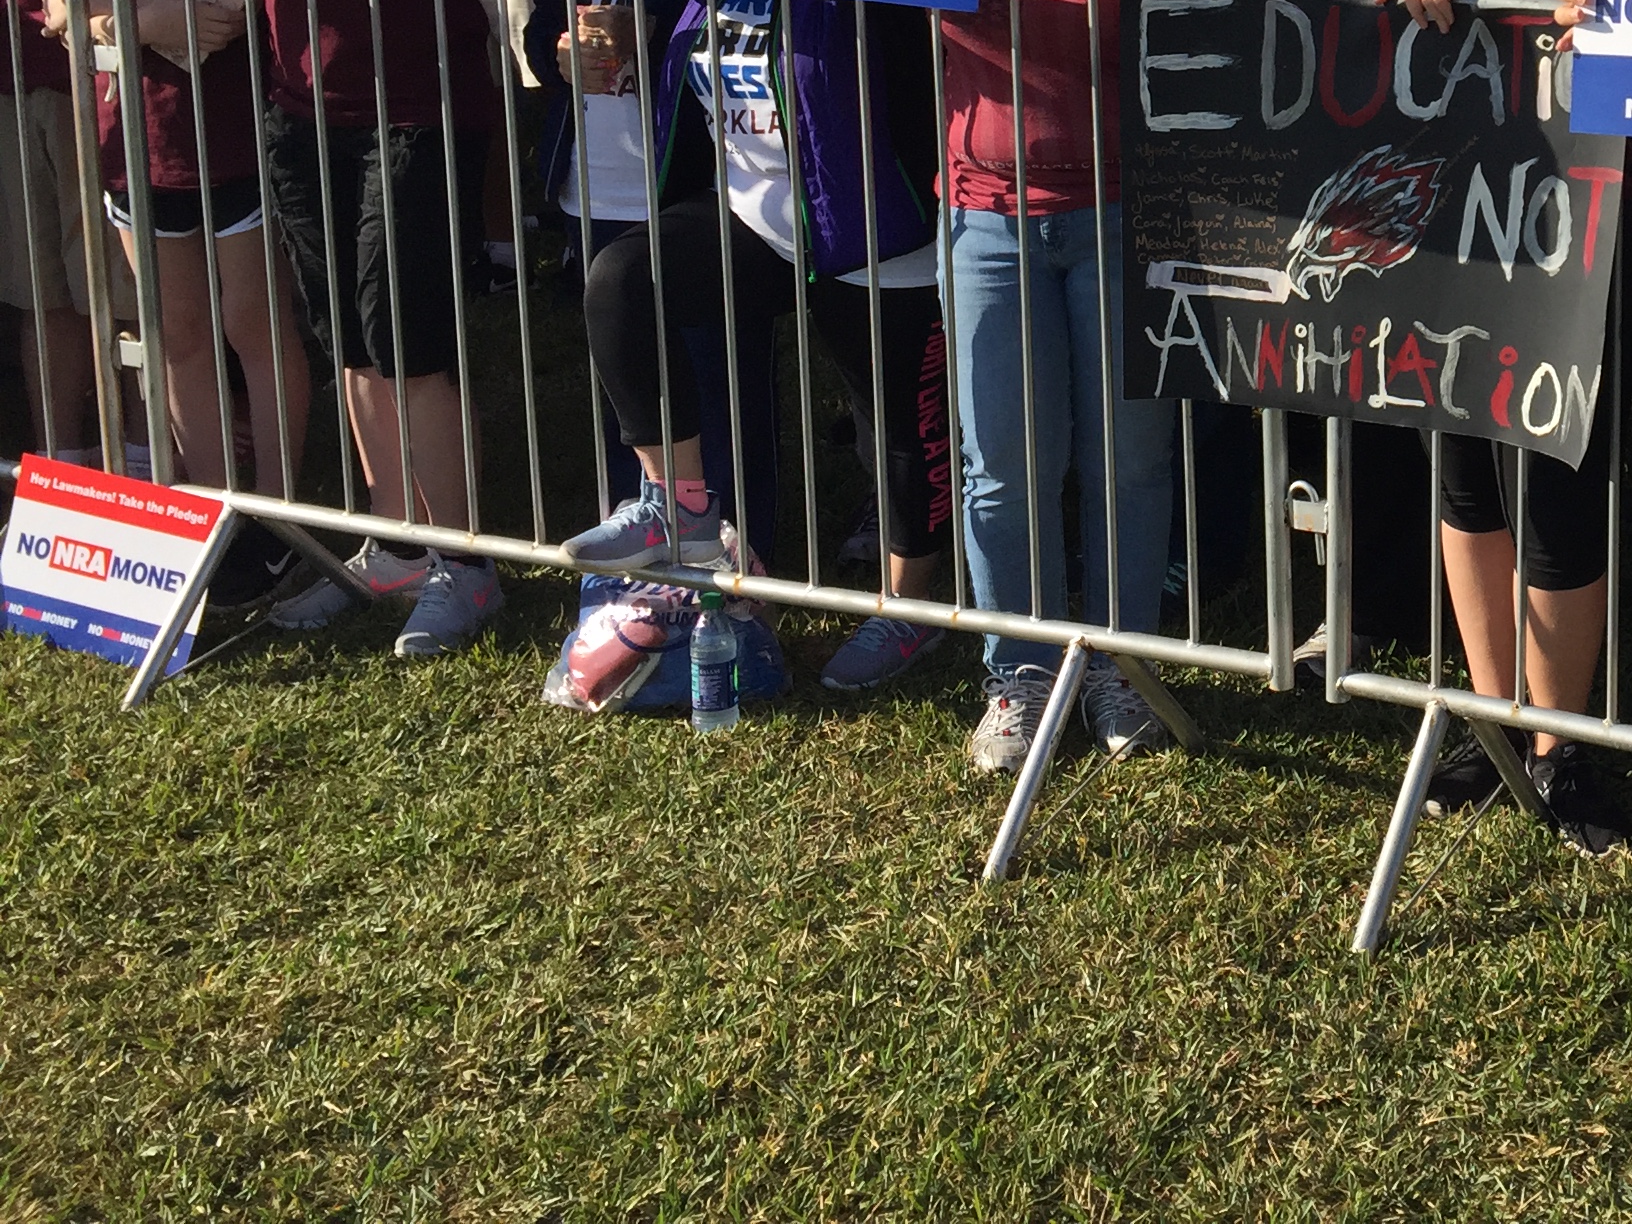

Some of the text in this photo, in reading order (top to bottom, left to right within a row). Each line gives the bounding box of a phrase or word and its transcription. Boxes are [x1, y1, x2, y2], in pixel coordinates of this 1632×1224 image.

[1457, 157, 1625, 282] NOT
[30, 471, 209, 526] Hey Lawmakers! Take the Pledge!
[17, 532, 108, 578] NO NRA
